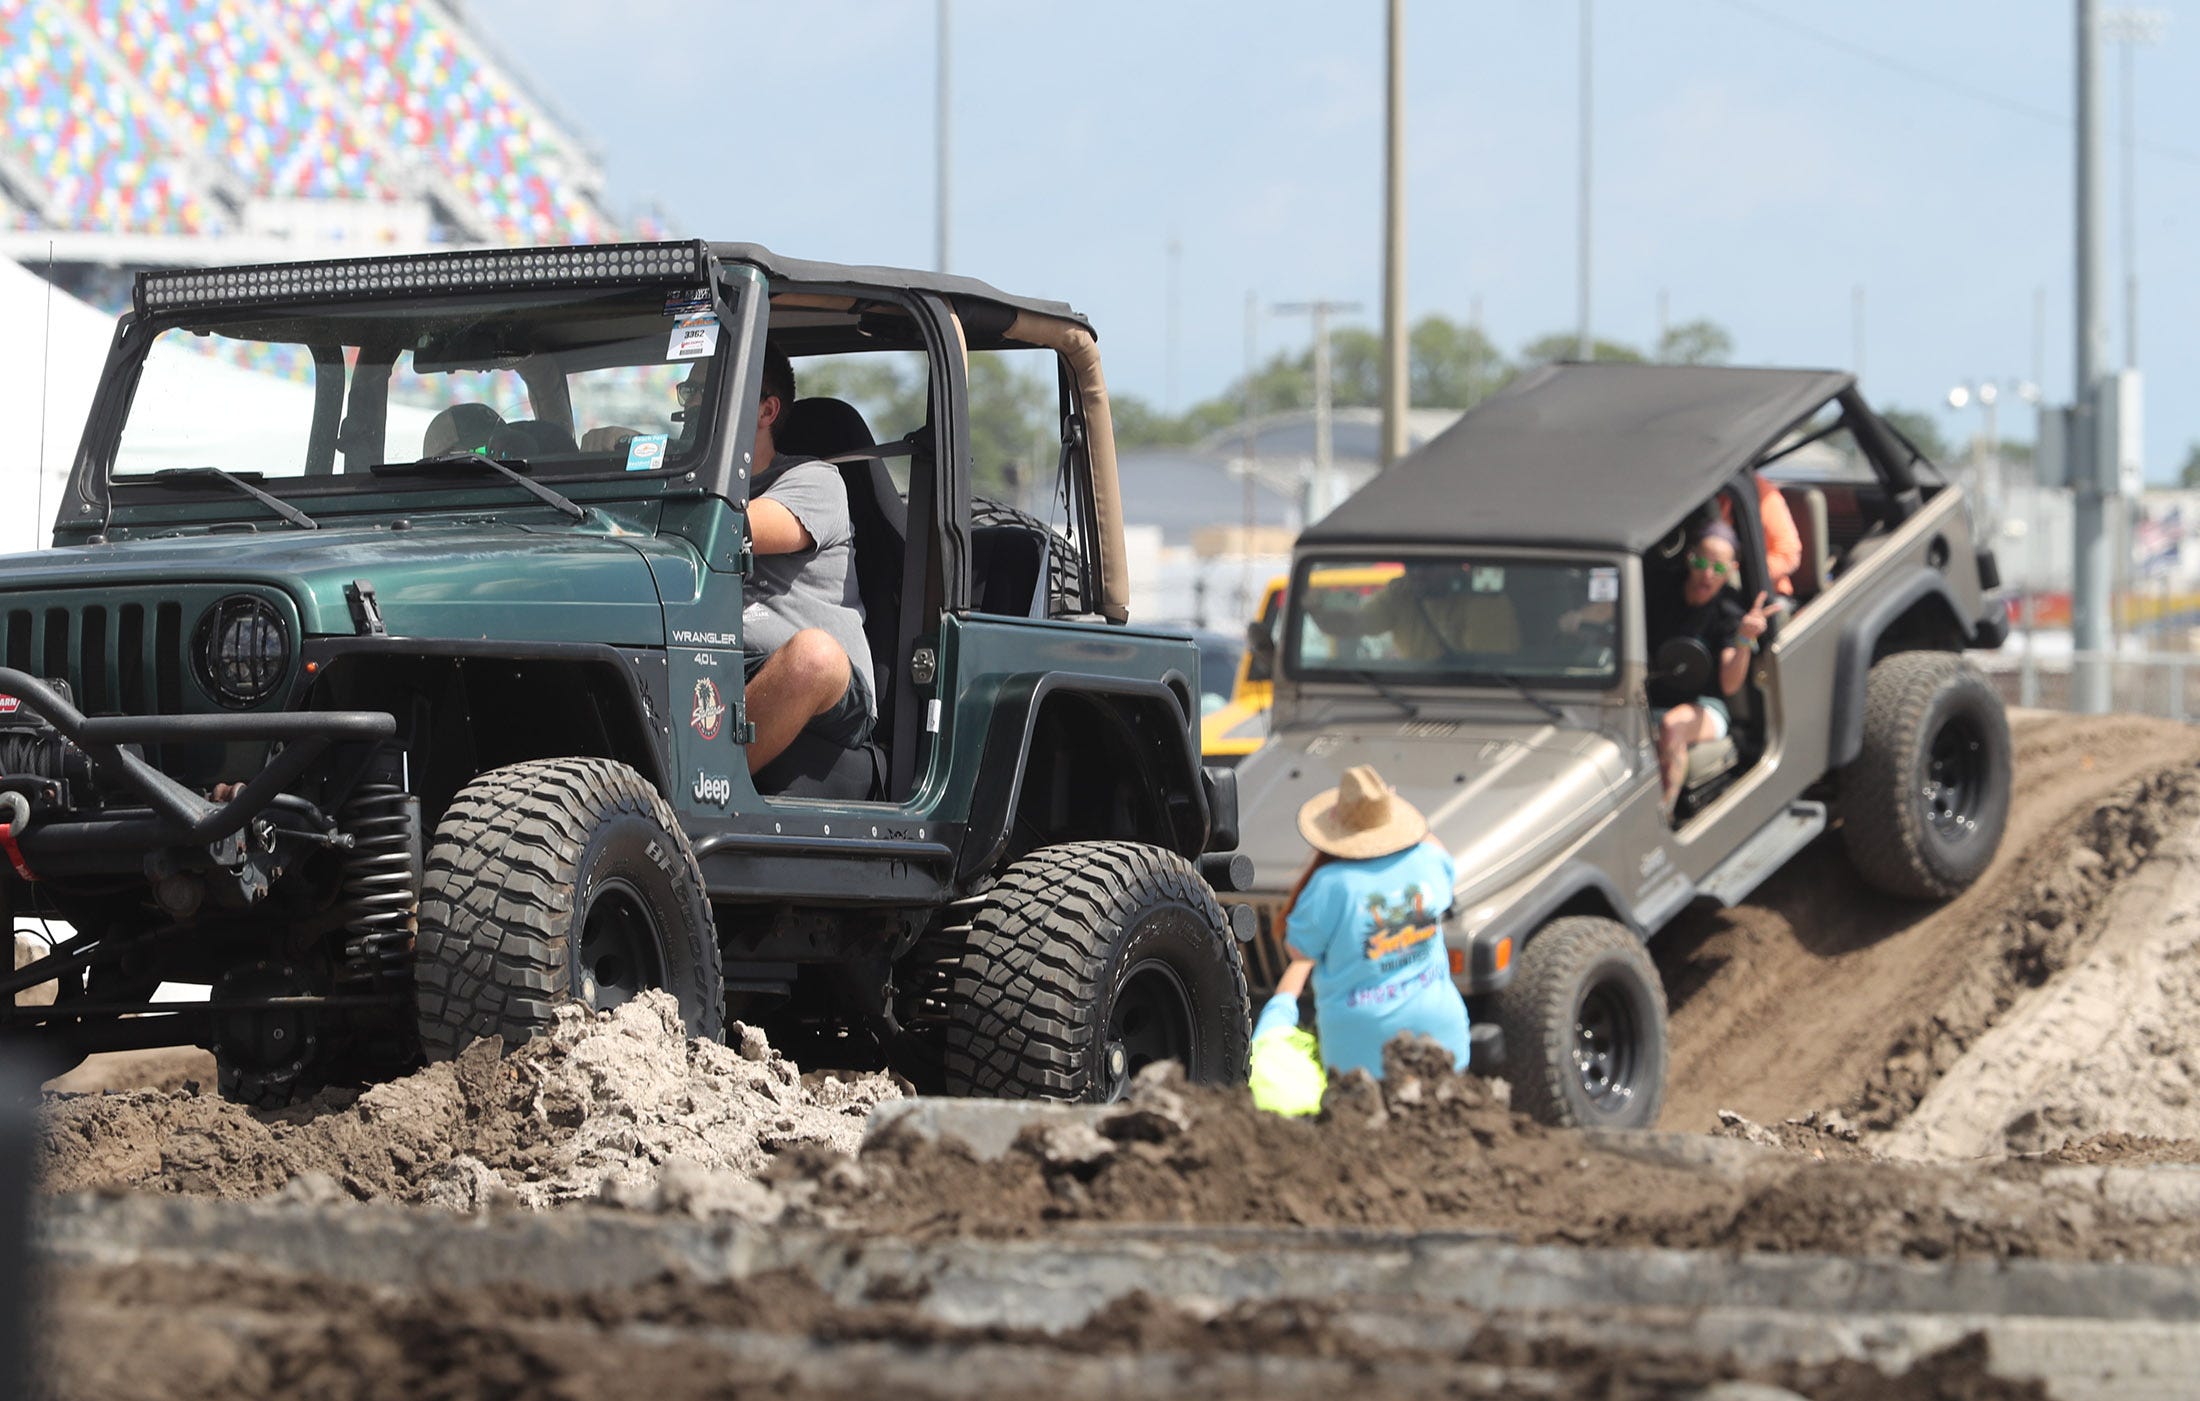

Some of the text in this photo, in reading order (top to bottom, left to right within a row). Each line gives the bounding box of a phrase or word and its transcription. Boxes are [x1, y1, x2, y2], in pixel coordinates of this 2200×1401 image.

[672, 630, 736, 645] WRANGLER
[0, 698, 17, 706] ARN
[694, 771, 730, 805] Jeep
